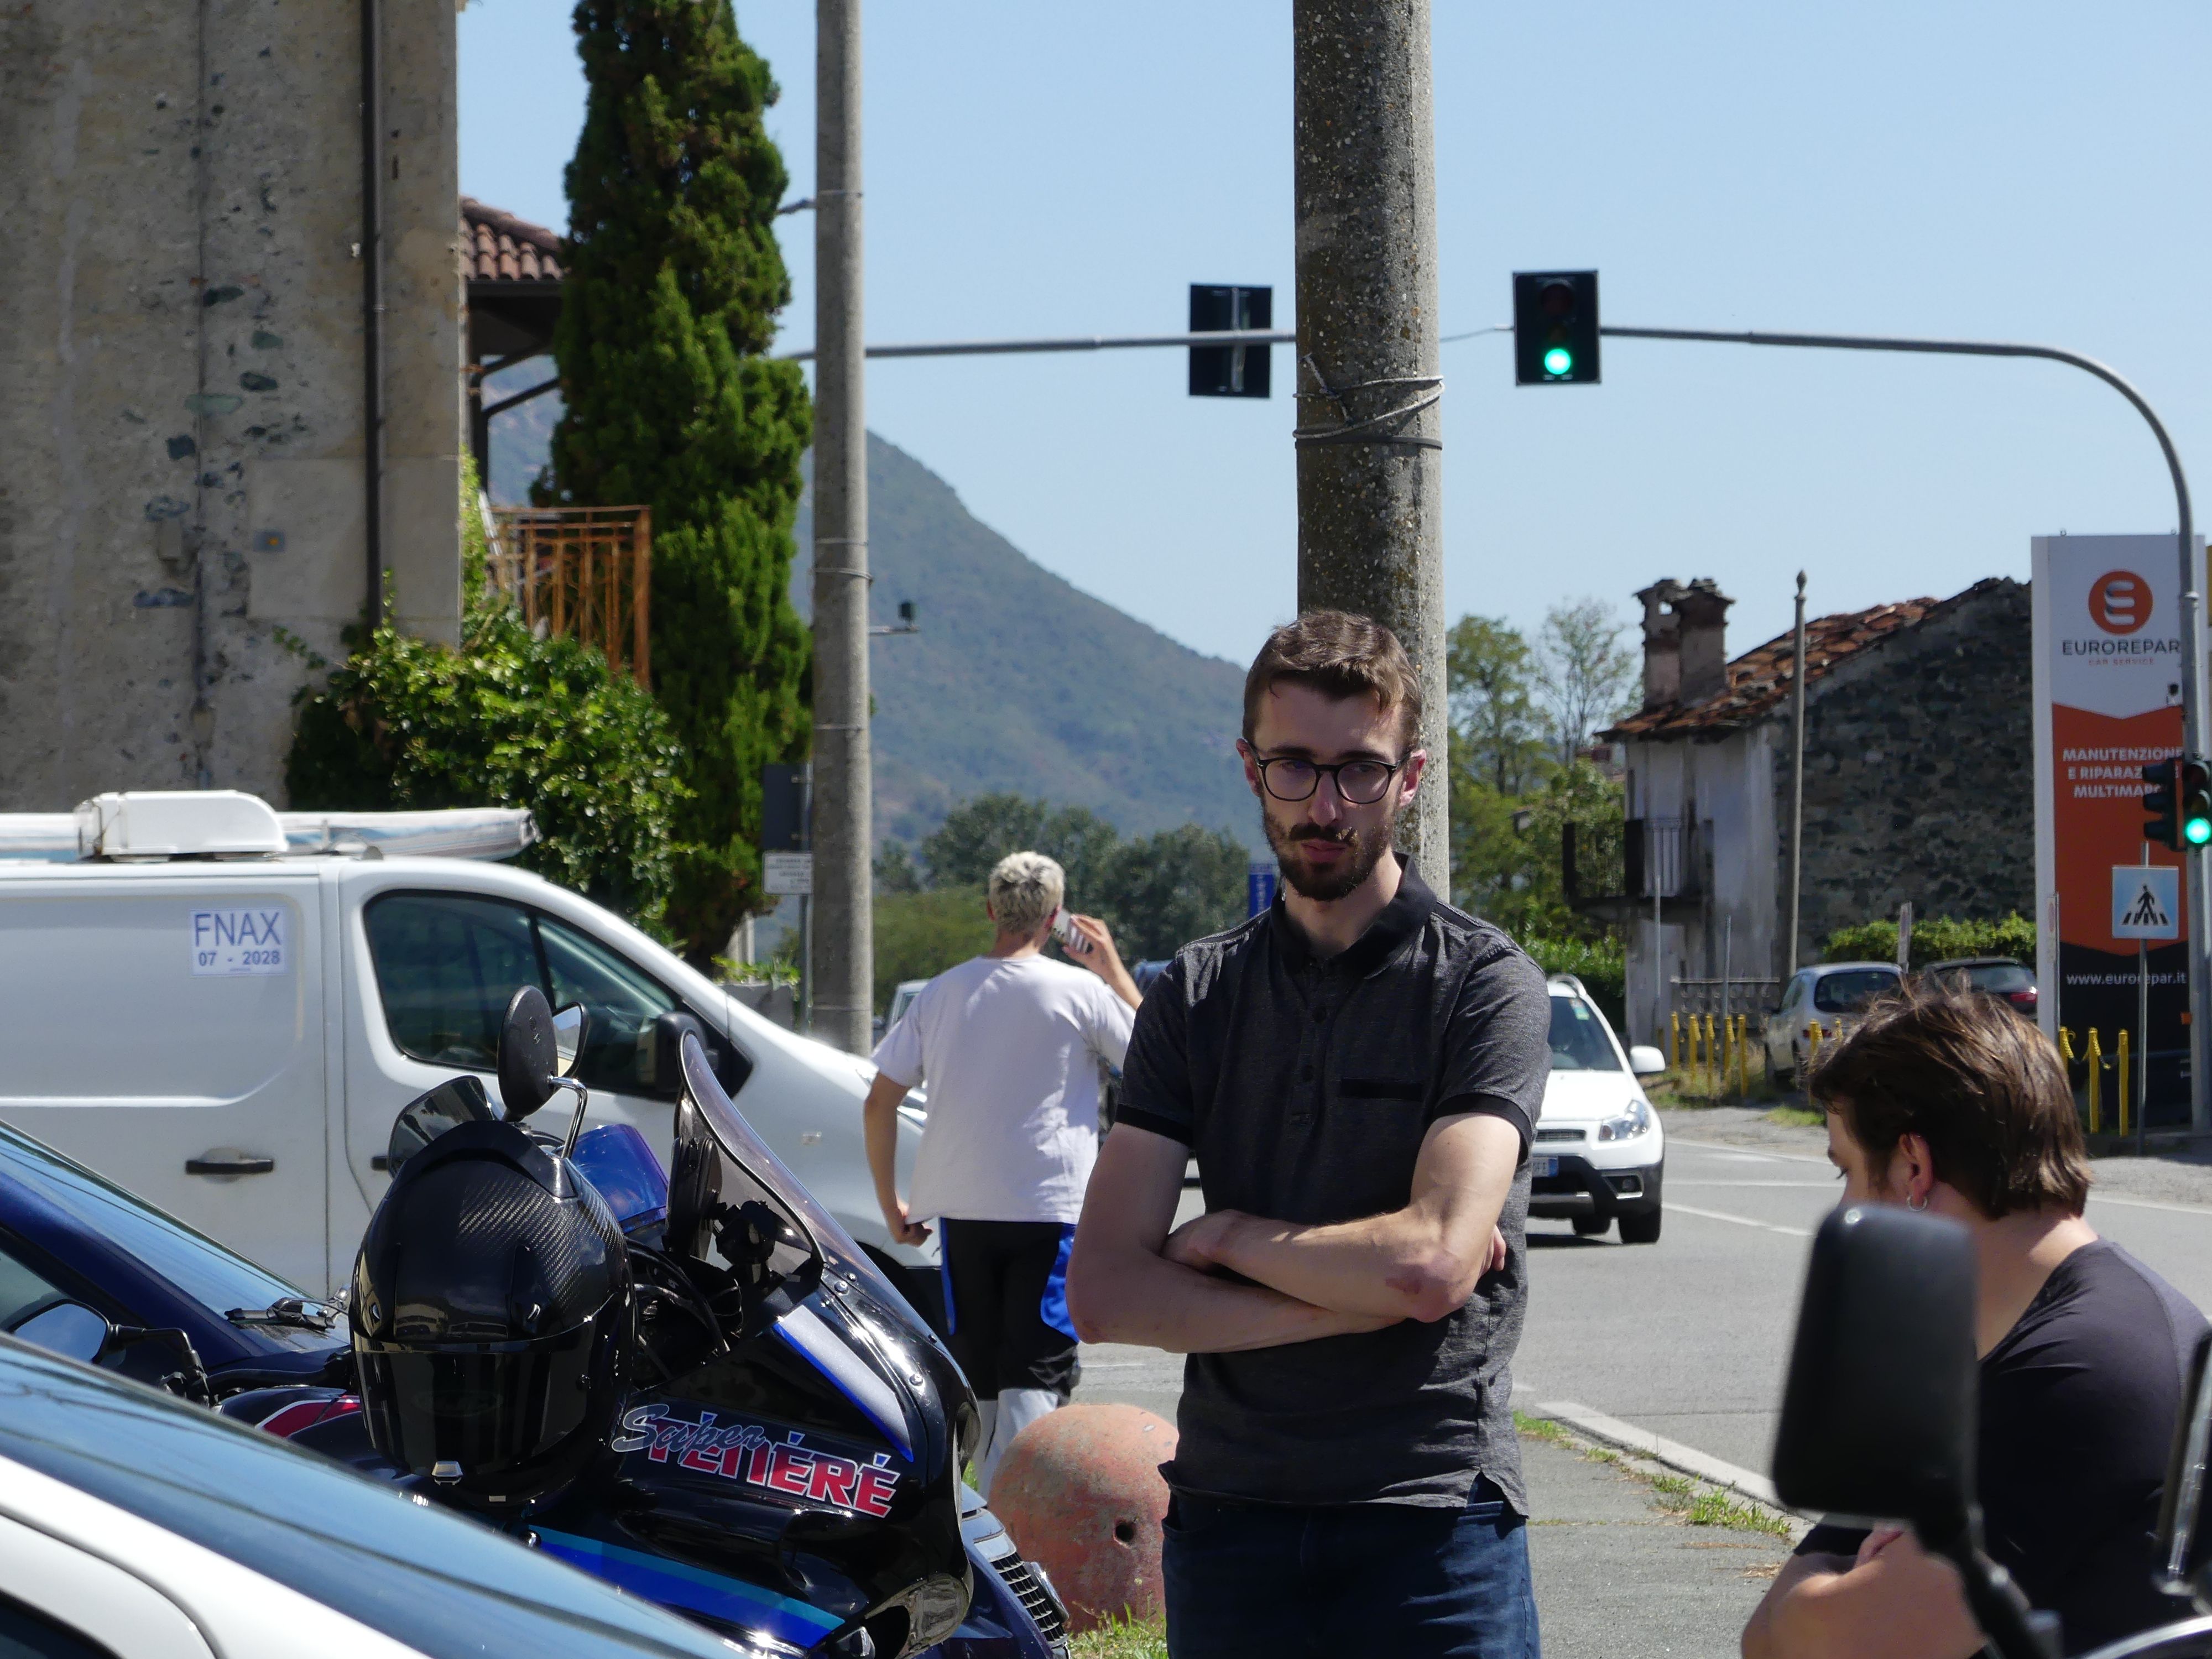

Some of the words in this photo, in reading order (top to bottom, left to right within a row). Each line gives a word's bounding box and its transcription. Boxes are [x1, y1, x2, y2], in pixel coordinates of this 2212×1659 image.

[2062, 638, 2180, 656] EUROREPAR
[2113, 658, 2154, 666] SERVICE
[2068, 766, 2077, 780] E
[195, 912, 281, 947] FNAX
[199, 951, 216, 967] 07
[243, 951, 280, 965] 2028
[611, 1402, 768, 1465] Super
